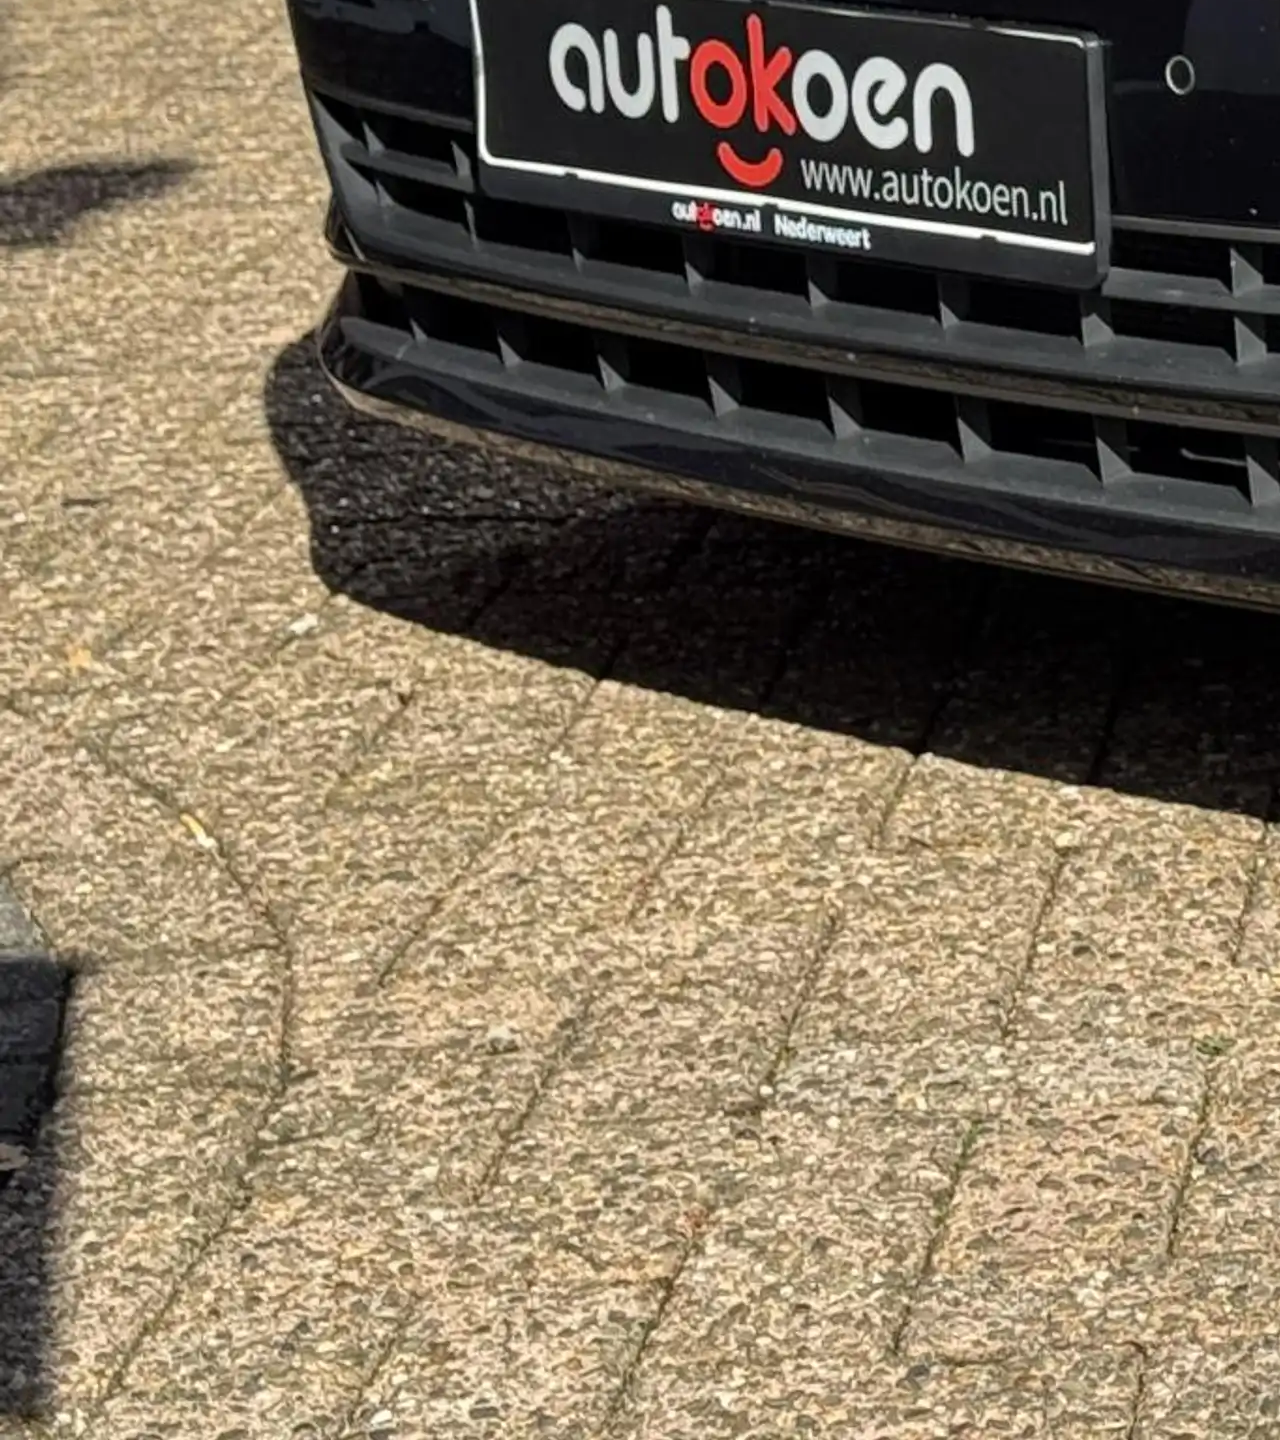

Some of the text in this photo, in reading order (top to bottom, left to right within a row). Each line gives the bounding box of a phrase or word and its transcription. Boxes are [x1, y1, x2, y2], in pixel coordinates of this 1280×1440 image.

[549, 4, 975, 158] autokoen
[800, 158, 1068, 226] www.autokoen.nl
[774, 213, 873, 250] Nederweert
